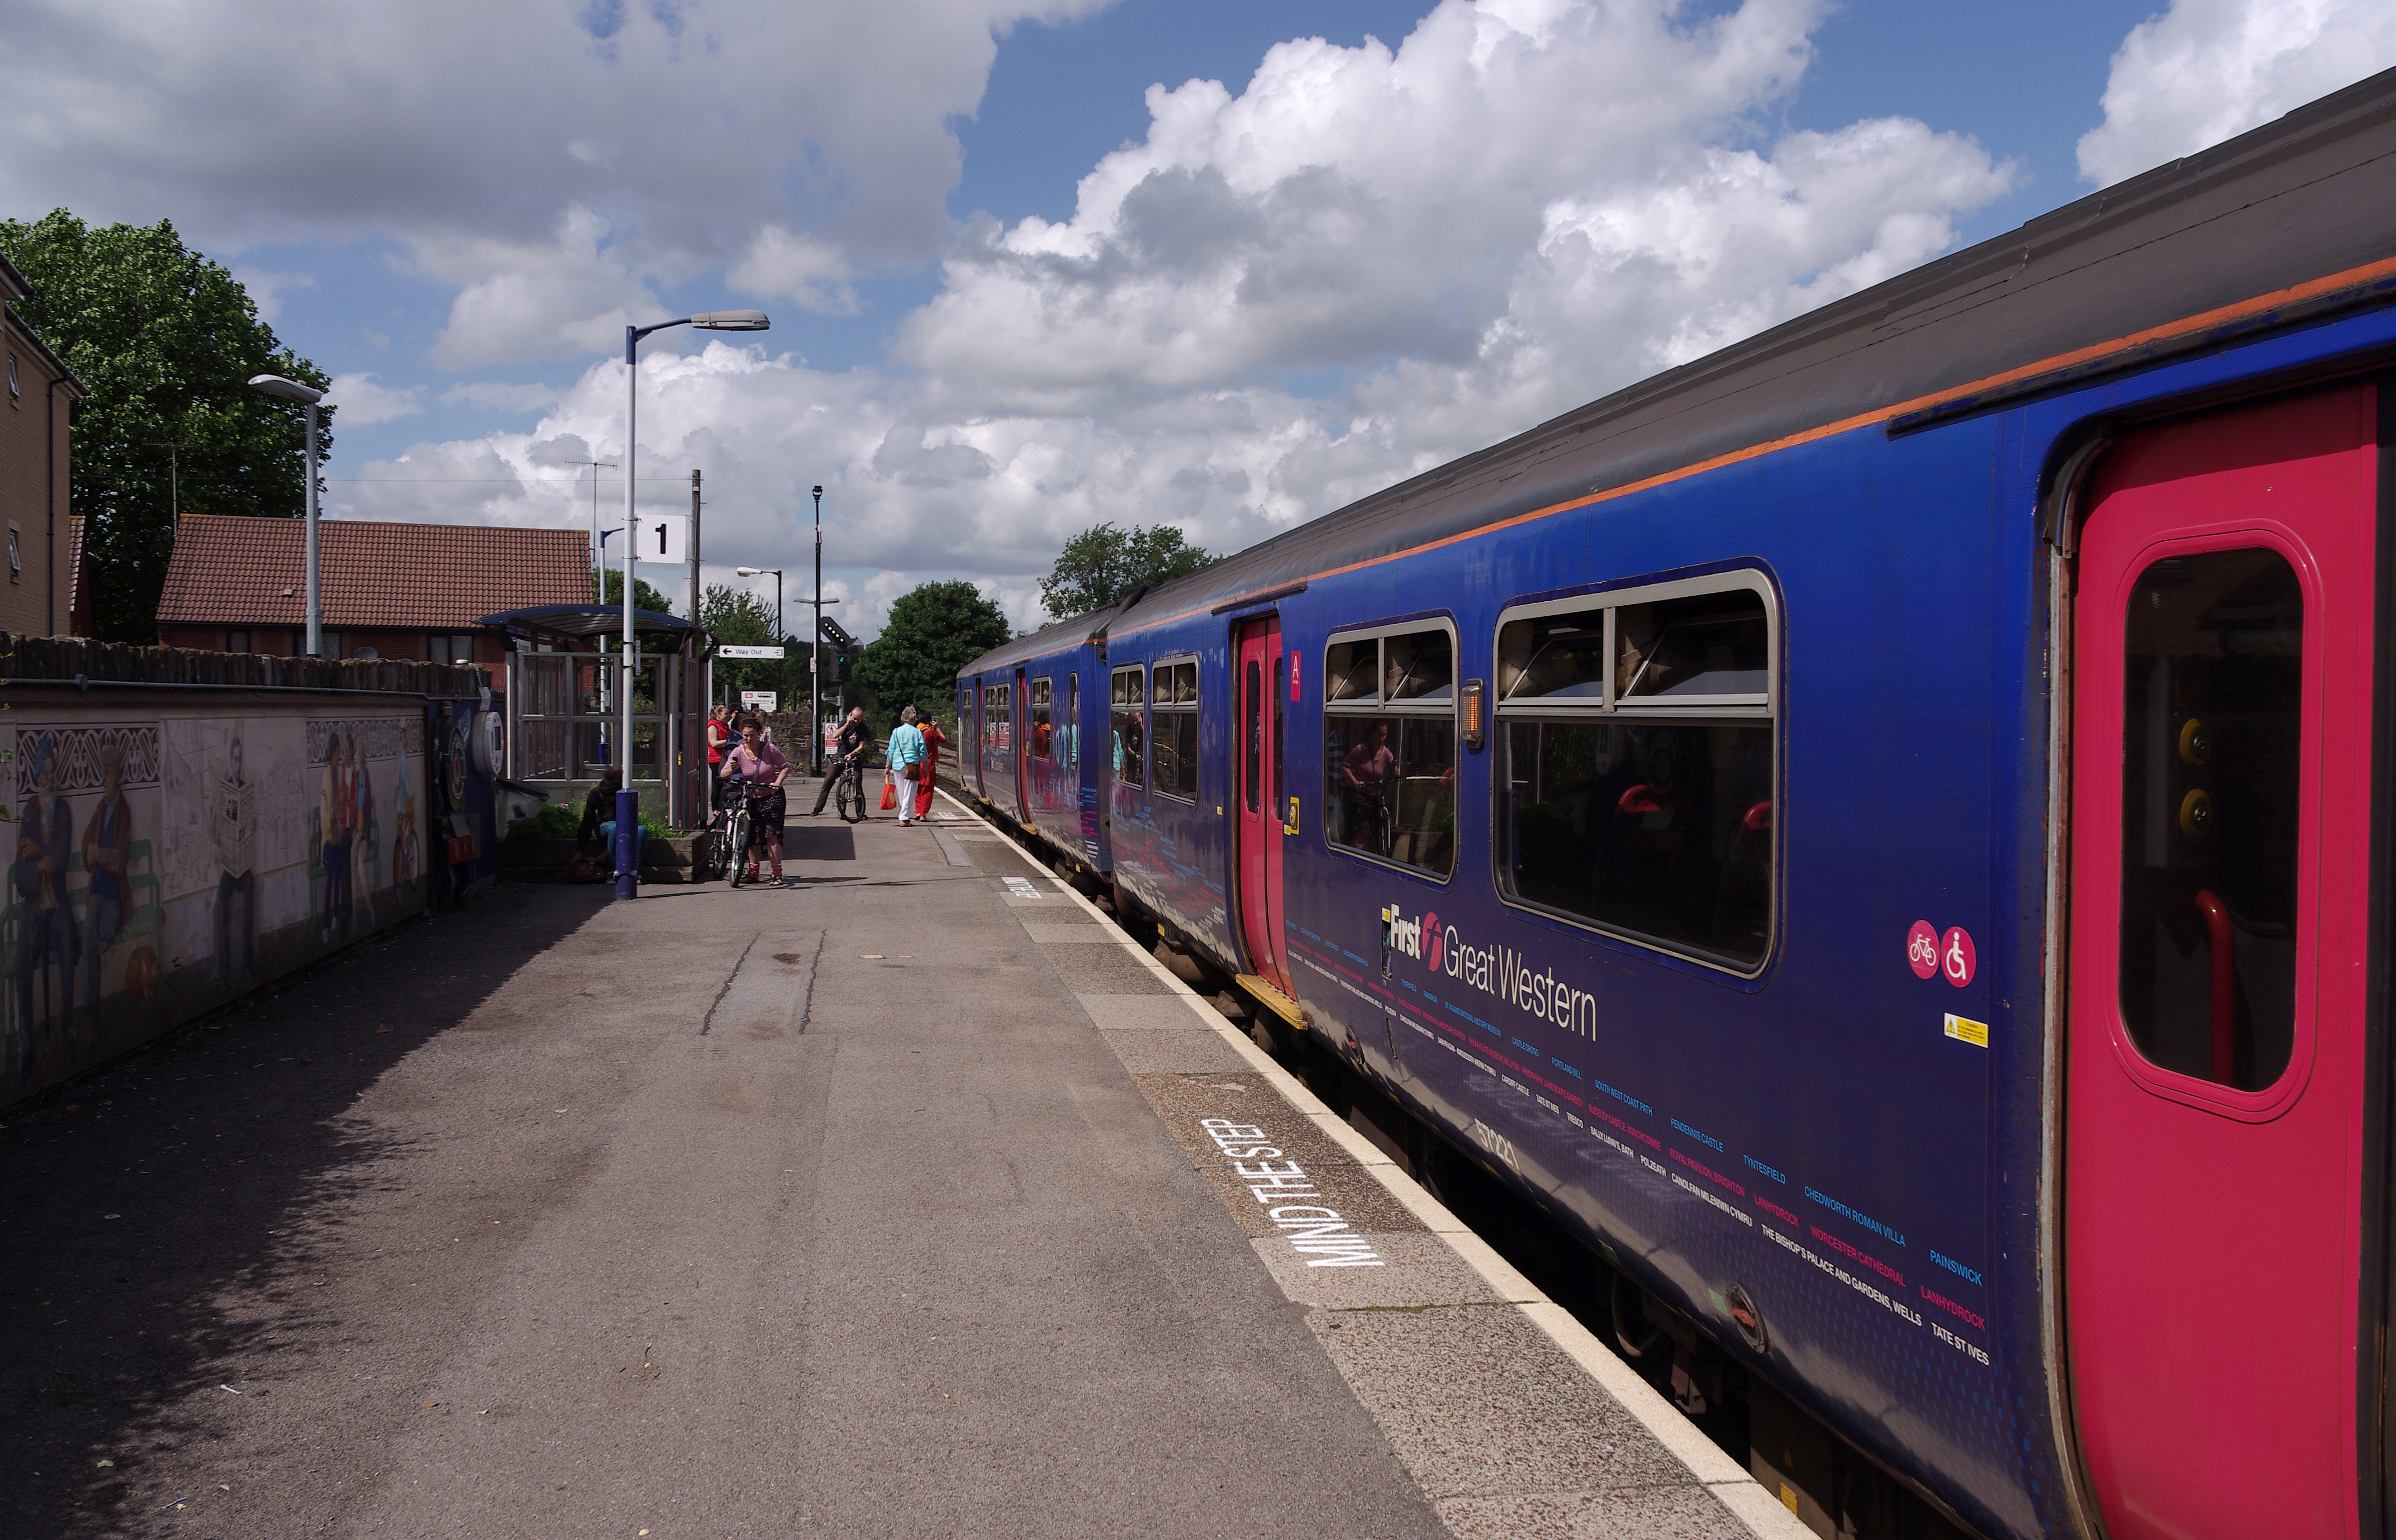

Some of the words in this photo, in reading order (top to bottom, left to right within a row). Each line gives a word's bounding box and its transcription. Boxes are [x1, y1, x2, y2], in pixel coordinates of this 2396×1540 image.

[655, 524, 667, 554] 1
[1292, 655, 1299, 678] A
[1391, 904, 1420, 959] First
[1444, 925, 1495, 995] Great
[1499, 944, 1596, 1042] Western
[1515, 1083, 1529, 1096] CASTLE
[1573, 1068, 1581, 1079] BILL
[1595, 1080, 1610, 1094] SOUTH
[1610, 1087, 1623, 1100] WEST
[1624, 1094, 1639, 1109] COAST
[1640, 1102, 1652, 1115] PATH
[1201, 1119, 1282, 1158] STEP
[1567, 1112, 1583, 1128] TRESCO
[1671, 1118, 1701, 1140] PENDENNIS
[1701, 1134, 1723, 1152] CASTLE
[1474, 1118, 1519, 1170] 57221
[1590, 1127, 1603, 1140] SALLY
[1622, 1144, 1634, 1158] BATH
[1233, 1161, 1321, 1203] THE
[1641, 1155, 1666, 1177] POLZEATH
[1714, 1172, 1744, 1197] BRIGHTON
[1743, 1154, 1785, 1183] TYNTESFIELD
[1672, 1173, 1700, 1197] CANOLFAN
[1730, 1206, 1752, 1227] CYMRU
[1754, 1195, 1799, 1227] LANHYDROCK
[1805, 1186, 1851, 1218] CHEDWORTH
[1853, 1210, 1881, 1234] ROMAN
[1883, 1225, 1905, 1247] VILLA
[1268, 1206, 1385, 1267] MIND
[1762, 1224, 1775, 1240] THE
[1775, 1233, 1806, 1258] BISHOP'S
[1807, 1251, 1834, 1275] PALACE
[1812, 1227, 1857, 1259] WORCESTER
[1858, 1252, 1905, 1286] CATHEDRAL
[1931, 1250, 1982, 1286] PAINSWICK
[1836, 1268, 1851, 1284] AND
[1852, 1277, 1892, 1311] GARDENS,
[1893, 1300, 1922, 1326] WELLS
[1921, 1286, 1985, 1330] LANHYDROCK
[1932, 1323, 1953, 1345] TATE
[1955, 1337, 1966, 1352] ST
[1968, 1343, 1989, 1365] IVES
